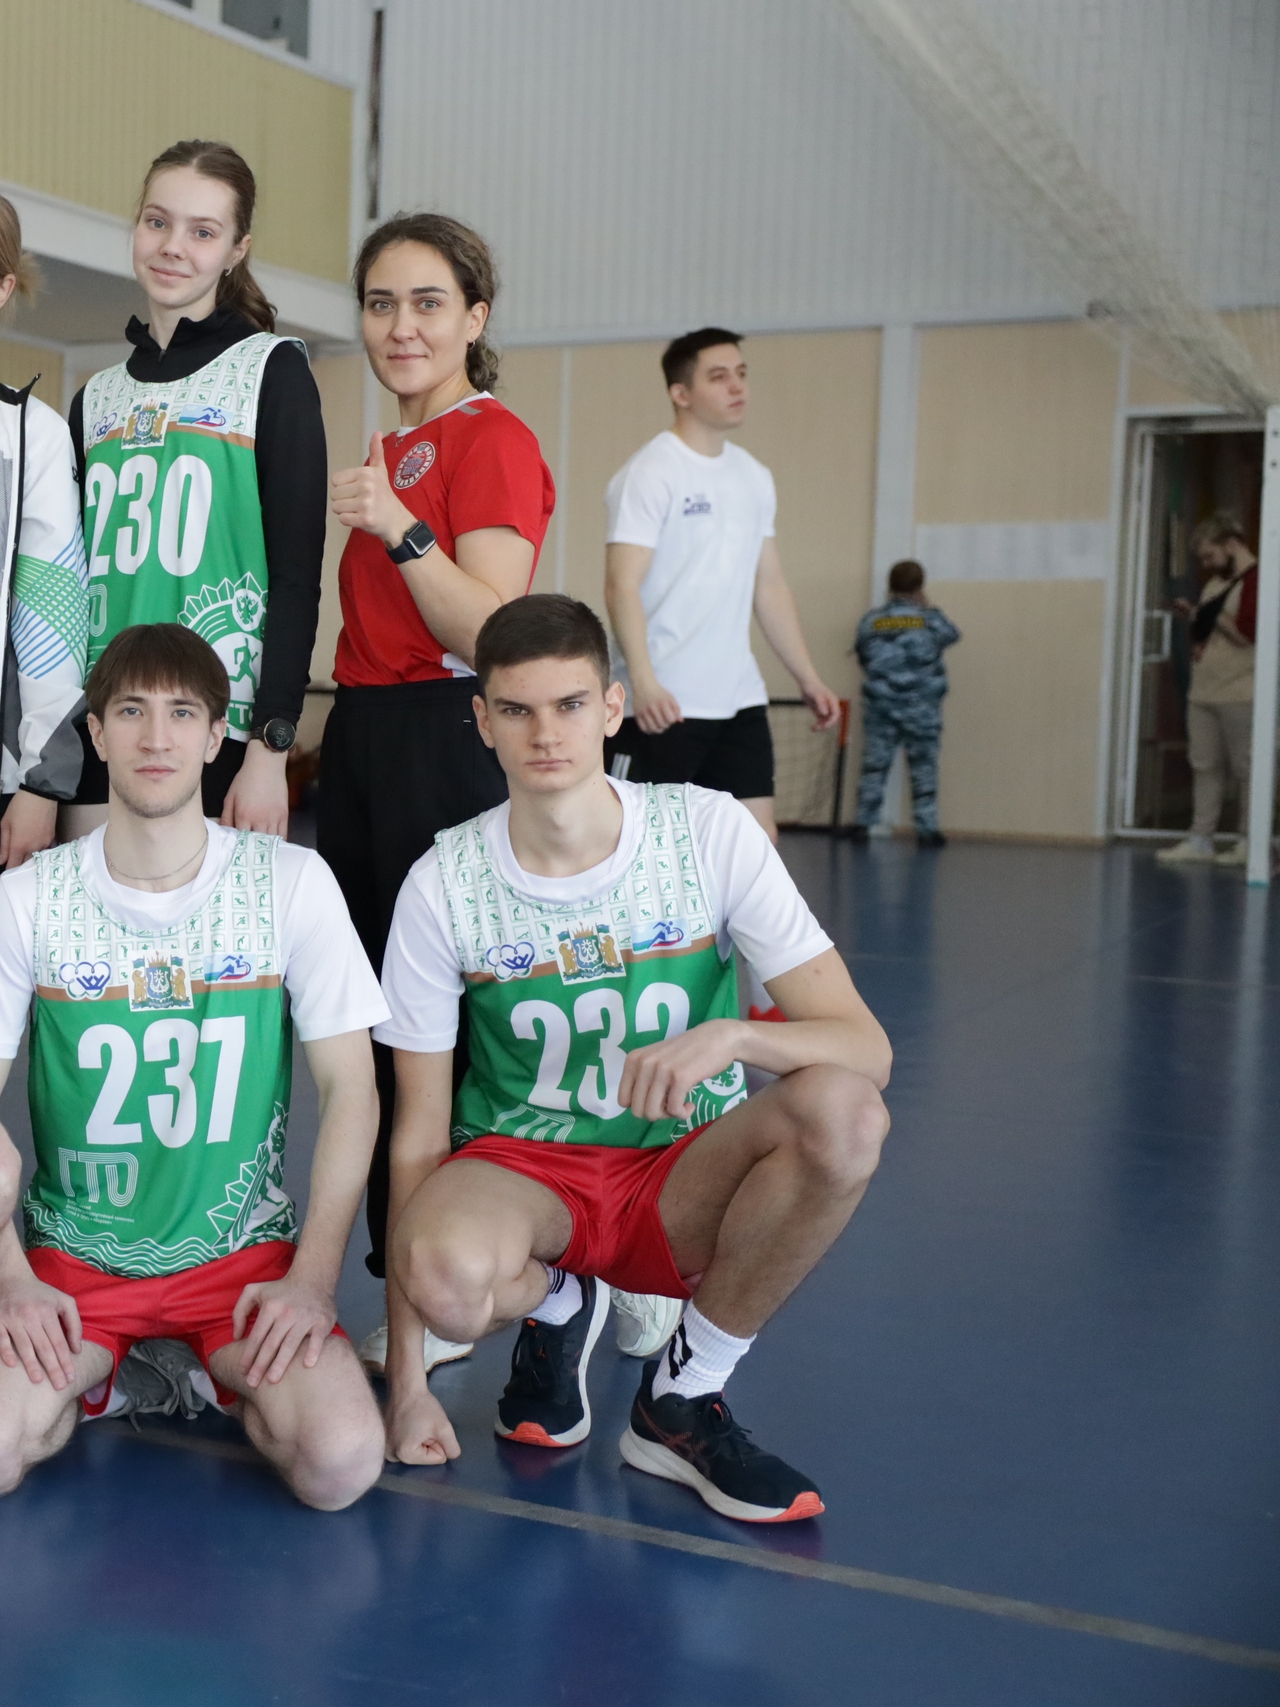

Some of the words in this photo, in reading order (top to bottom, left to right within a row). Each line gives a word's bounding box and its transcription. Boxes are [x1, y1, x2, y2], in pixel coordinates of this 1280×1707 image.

[85, 454, 212, 577] 230
[225, 703, 254, 725] ГТ
[78, 1015, 246, 1148] 237
[58, 1147, 139, 1207] ГТО
